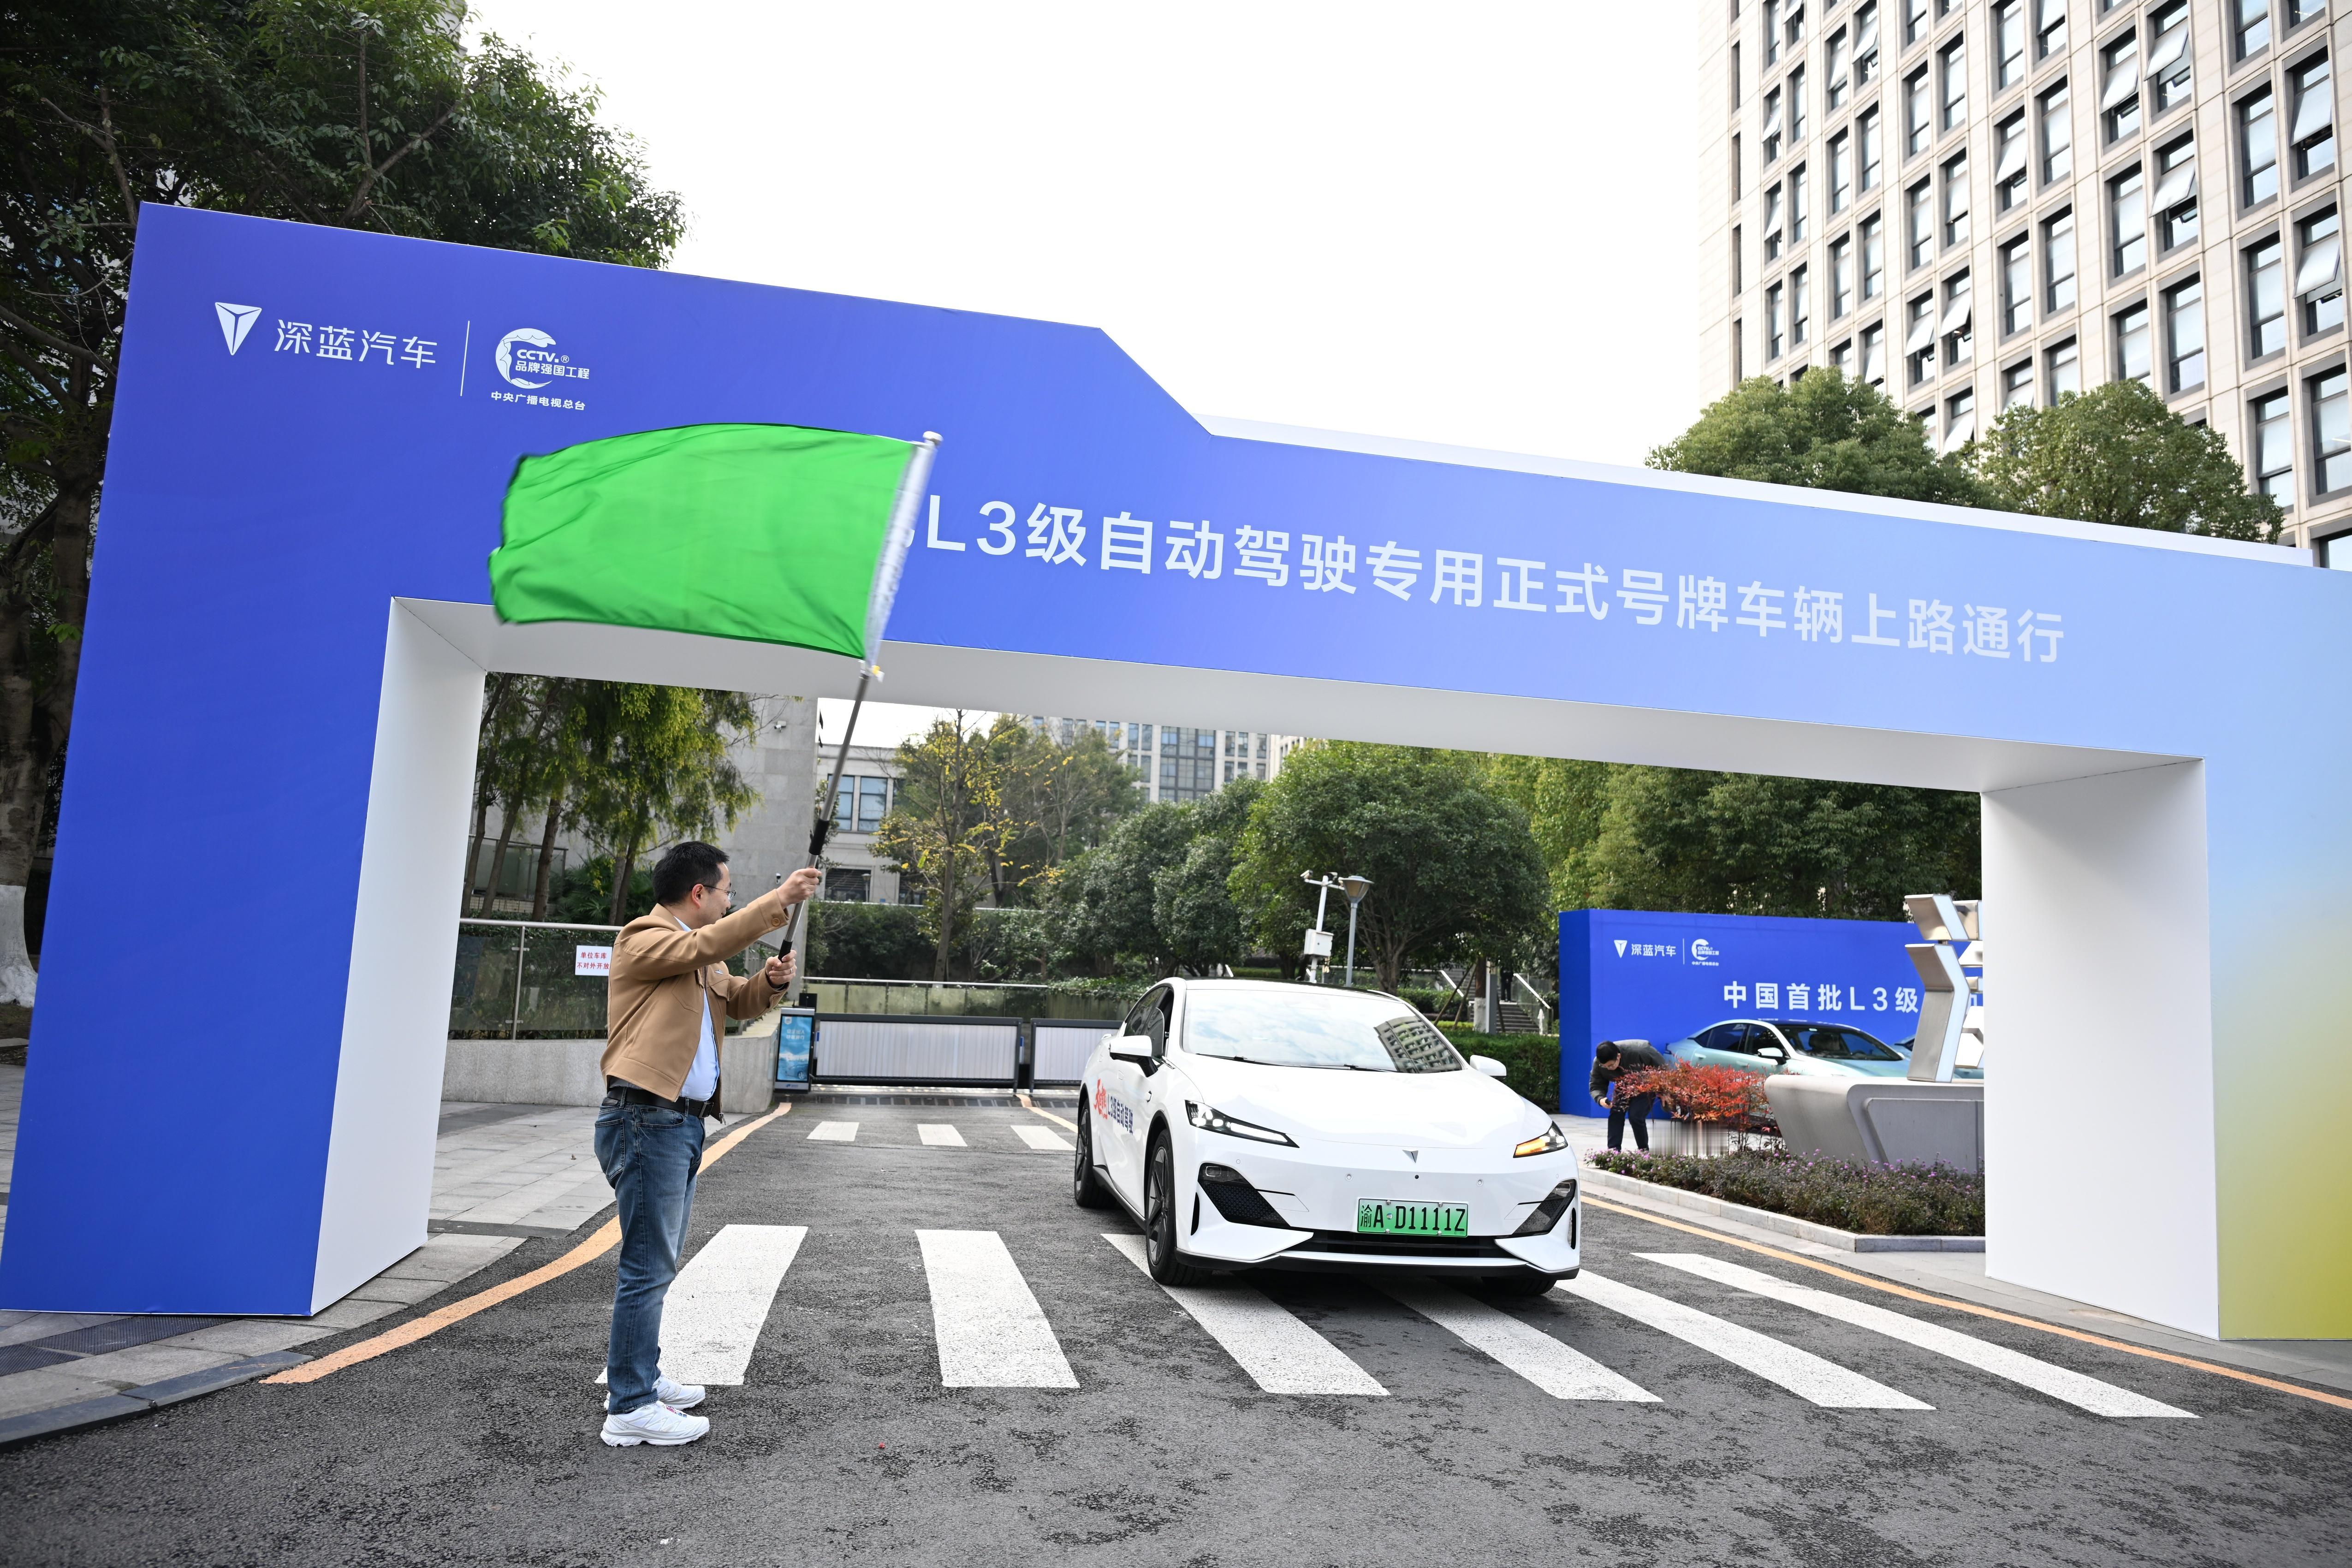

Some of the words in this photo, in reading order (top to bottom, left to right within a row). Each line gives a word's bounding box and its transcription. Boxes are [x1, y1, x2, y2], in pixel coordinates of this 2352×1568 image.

[274, 320, 437, 368] 深蓝汽车
[515, 360, 590, 379] 品牌强国工程
[491, 391, 586, 410] 中央广播电视总台
[905, 494, 2064, 663] L3级自动驾驶专用正式号牌车辆上路通行
[1631, 944, 1676, 957] 深蓝汽车
[1724, 981, 1977, 1013] 中国首批L3级
[1108, 1094, 1133, 1135] L3级自动驾驶
